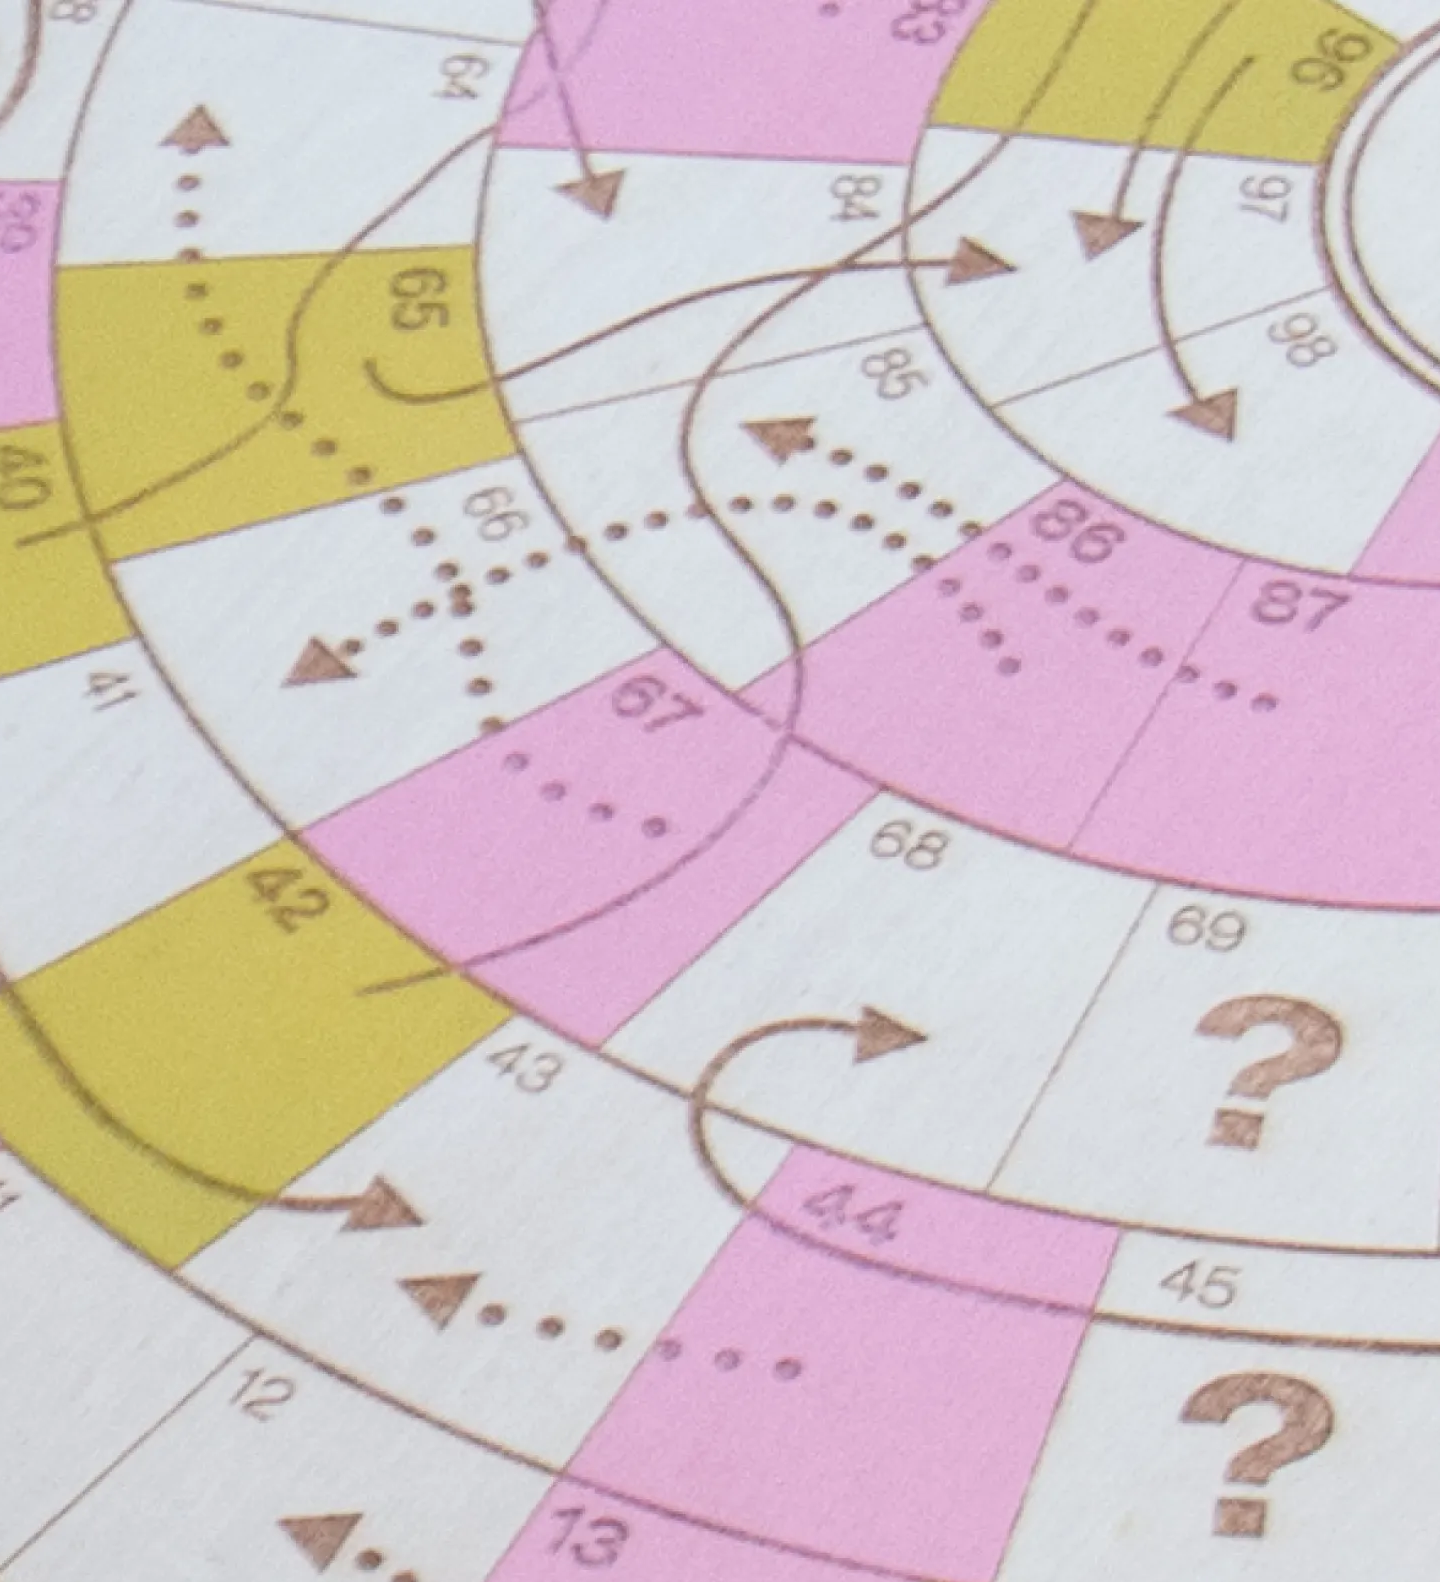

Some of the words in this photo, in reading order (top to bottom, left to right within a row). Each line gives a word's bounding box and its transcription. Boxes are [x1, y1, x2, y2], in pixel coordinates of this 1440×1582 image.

[430, 53, 492, 101] 64
[1290, 27, 1373, 92] 96
[829, 174, 882, 224] 84
[1239, 175, 1293, 224] 97
[389, 266, 451, 332] 65
[1267, 311, 1339, 369] 98
[859, 347, 929, 402] 85
[461, 485, 530, 544] 66
[1029, 499, 1127, 567] 86
[1250, 577, 1352, 634] 87
[80, 670, 142, 713] 41
[609, 674, 706, 734] 67
[868, 818, 951, 872] 68
[243, 864, 331, 935] 42
[1165, 903, 1248, 953] 69
[486, 1041, 566, 1095] 43
[800, 1183, 906, 1246] 44
[1158, 1259, 1244, 1308] 45
[228, 1366, 298, 1422] 12
[545, 1505, 630, 1568] 13
